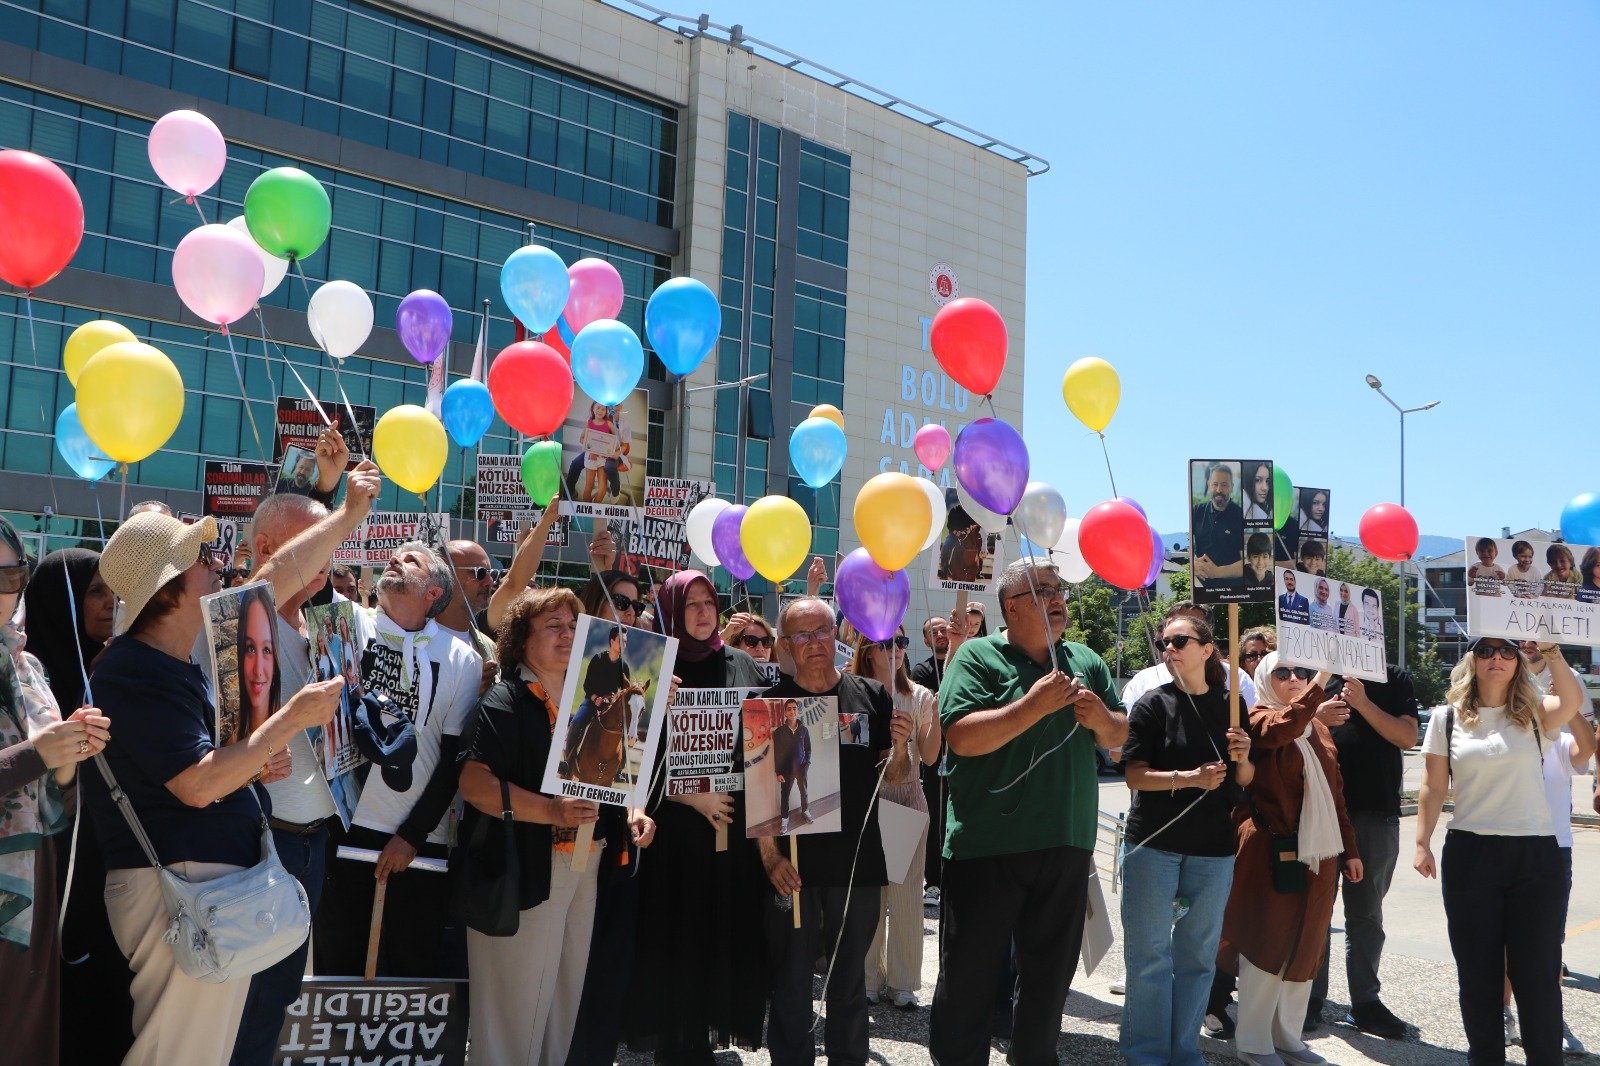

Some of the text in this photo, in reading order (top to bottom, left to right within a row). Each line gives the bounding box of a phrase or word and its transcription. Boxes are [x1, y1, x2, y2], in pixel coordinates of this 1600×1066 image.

[901, 364, 969, 413] BOLU
[295, 400, 317, 411] TÜM
[279, 424, 305, 436] YARGI
[221, 462, 242, 473] TÜM
[478, 456, 498, 466] GRAND
[207, 472, 265, 484] SORUMLULAR
[648, 478, 669, 488] YARIM
[207, 484, 261, 496] YARGI ÖNÜNE
[478, 482, 526, 495] MÜZESİN
[648, 488, 688, 499] ADALET
[576, 505, 592, 514] ALYA
[605, 506, 629, 517] KÜBRA
[366, 513, 419, 525] YARIM KALAN
[367, 524, 416, 538] ADALET
[629, 536, 683, 561] BAKANI
[1509, 600, 1572, 610] KARTALKAYA
[1506, 611, 1589, 638] ADALET!
[697, 691, 722, 706] KARTAL
[725, 691, 739, 705] OTEL
[671, 710, 733, 732] KÖTÜLÜK
[671, 732, 733, 752] MÜZESİNE
[670, 752, 733, 767] DÖNÜŞTÜRÜLSÜN!
[562, 782, 586, 798] YİĞİT
[672, 780, 684, 795] 78
[286, 992, 450, 1022] DEĞİLDİR
[280, 1021, 447, 1051] ADALET
